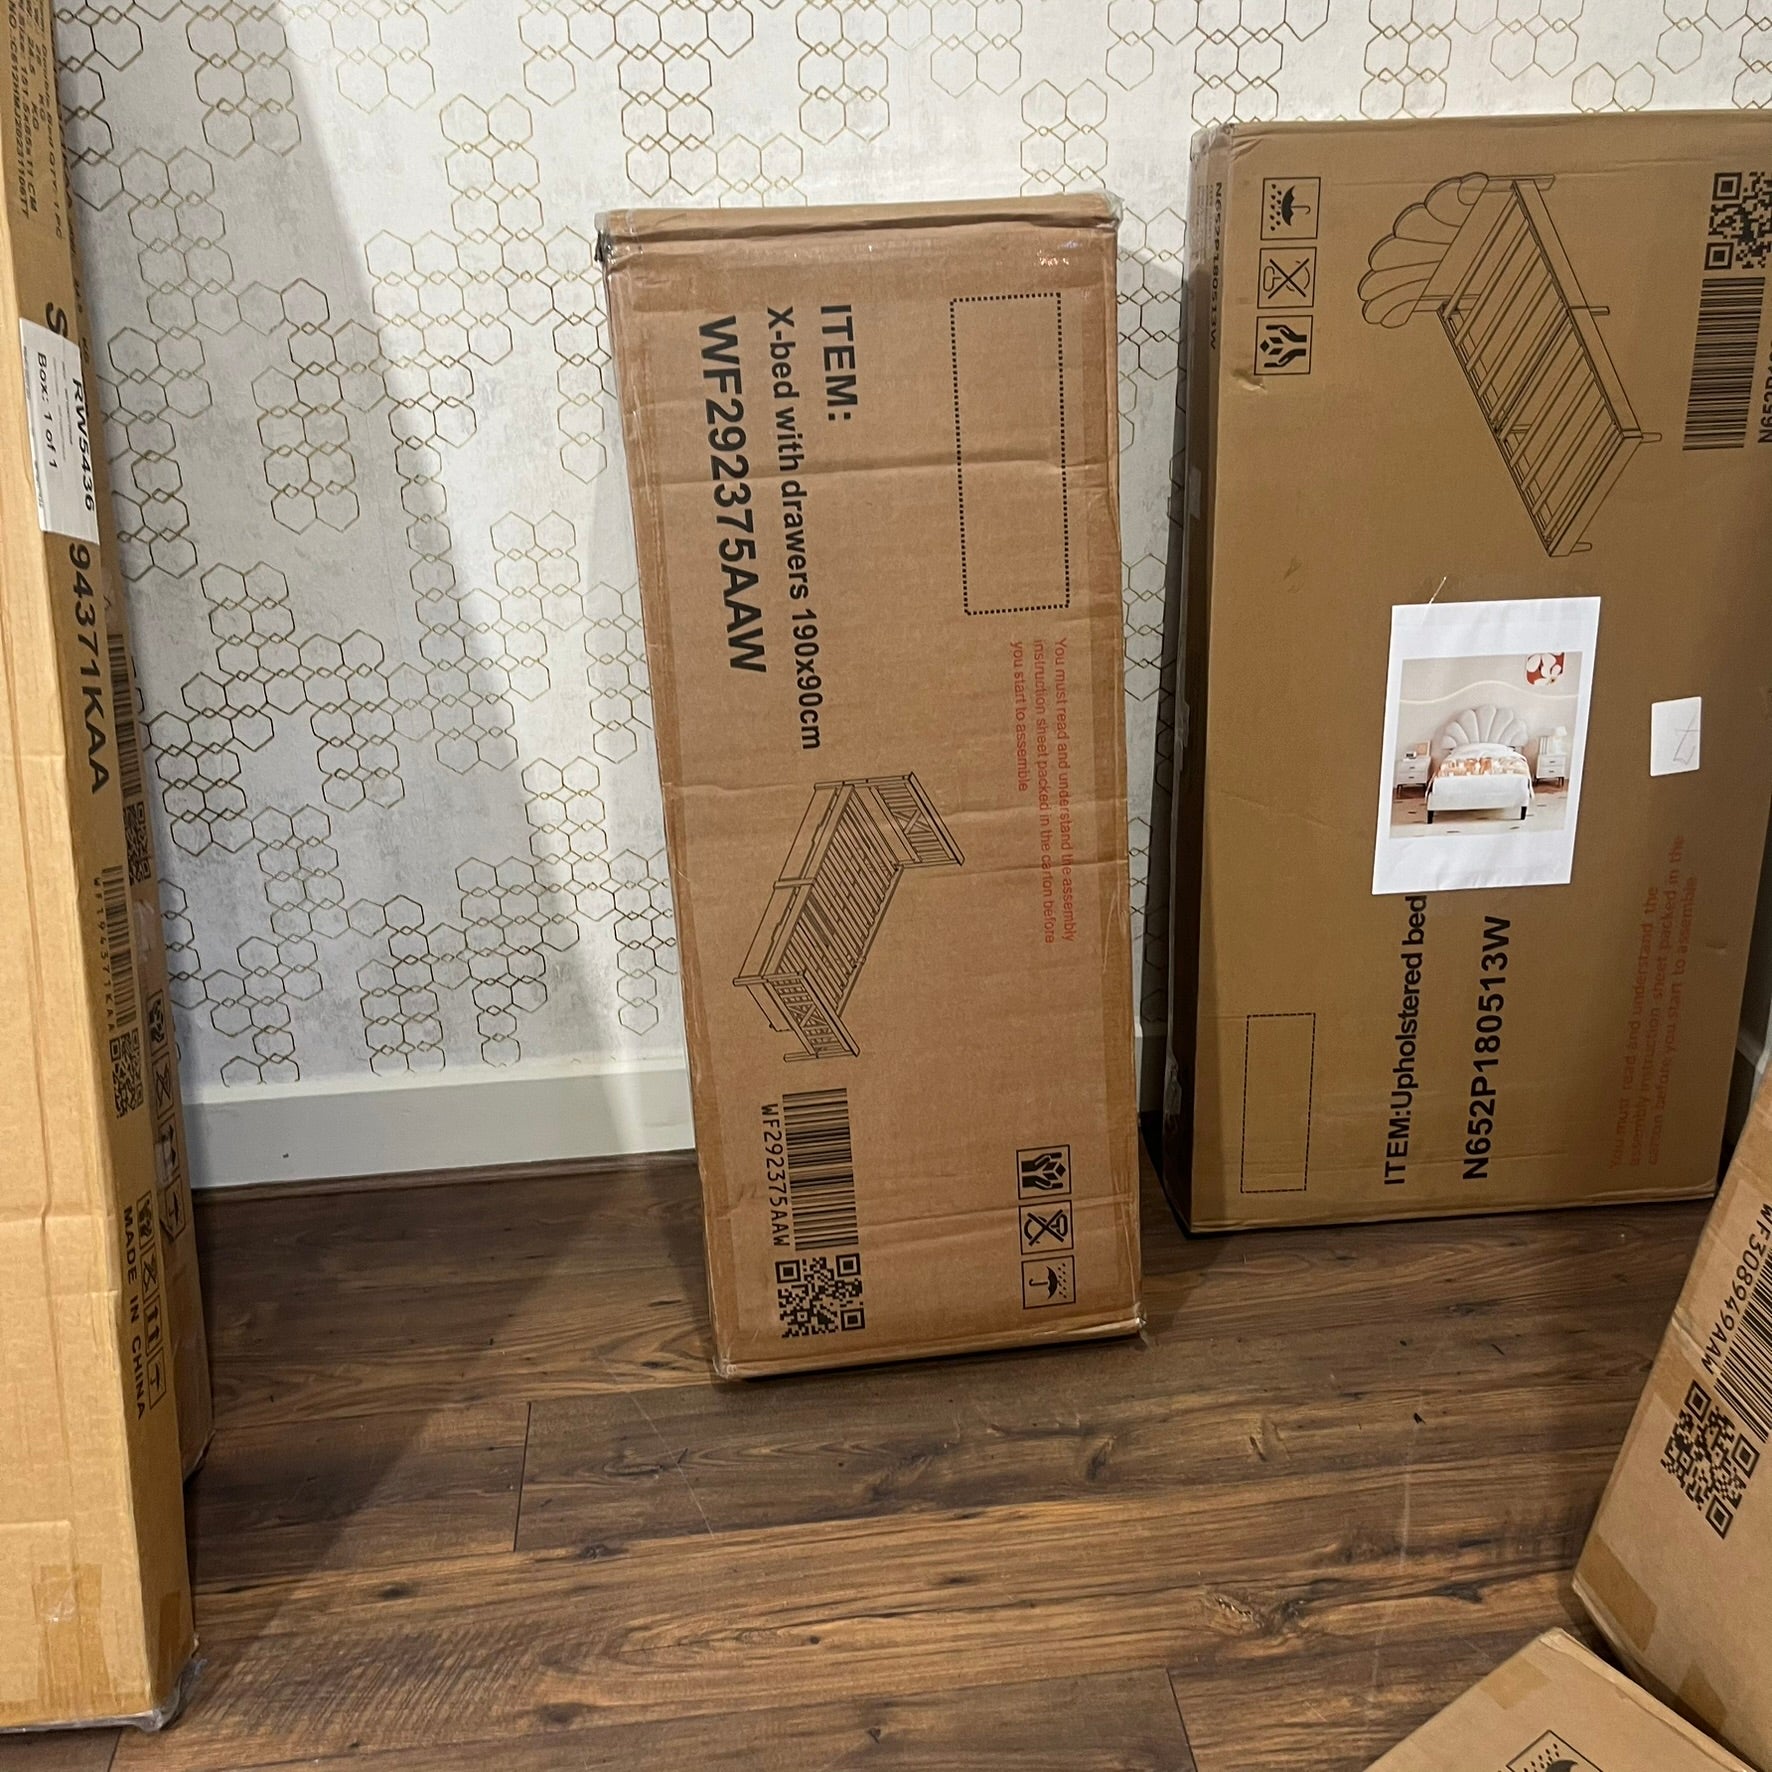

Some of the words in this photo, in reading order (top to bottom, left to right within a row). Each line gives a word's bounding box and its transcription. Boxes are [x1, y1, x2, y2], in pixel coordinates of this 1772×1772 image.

[820, 304, 858, 421] ITEM:
[37, 352, 49, 402] Box:
[46, 428, 57, 449] of
[72, 378, 95, 511] RW5436
[774, 406, 805, 472] with
[699, 315, 767, 673] WF292375AAW
[780, 479, 810, 600] drawers
[68, 542, 110, 794] 94371KAA
[792, 608, 824, 750] 190x90cm
[1010, 641, 1023, 667] you
[1034, 639, 1048, 714] instruction
[1055, 638, 1068, 665] You
[1014, 672, 1027, 704] start
[1015, 706, 1027, 721] to
[1055, 669, 1068, 705] must
[1036, 719, 1050, 758] sheet
[1056, 707, 1071, 739] read
[1016, 724, 1031, 792] assemble
[1036, 761, 1051, 810] packed
[1058, 743, 1071, 769] and
[1039, 814, 1051, 827] in
[1040, 830, 1053, 851] the
[1058, 773, 1073, 850] understand
[1041, 854, 1054, 898] carton
[1061, 854, 1074, 875] the
[1043, 900, 1056, 944] before
[1061, 878, 1077, 942] assembly
[1401, 895, 1428, 945] bed
[1644, 887, 1658, 914] the
[1384, 952, 1423, 1185] ITEM:Upholstered
[1462, 916, 1511, 1180] N652P180513W
[760, 1103, 791, 1247] WF292375AAW
[122, 1205, 138, 1285] MADE
[129, 1298, 140, 1324] IN
[1701, 1203, 1772, 1375] WF308949AAW
[131, 1335, 146, 1421] CHINA
